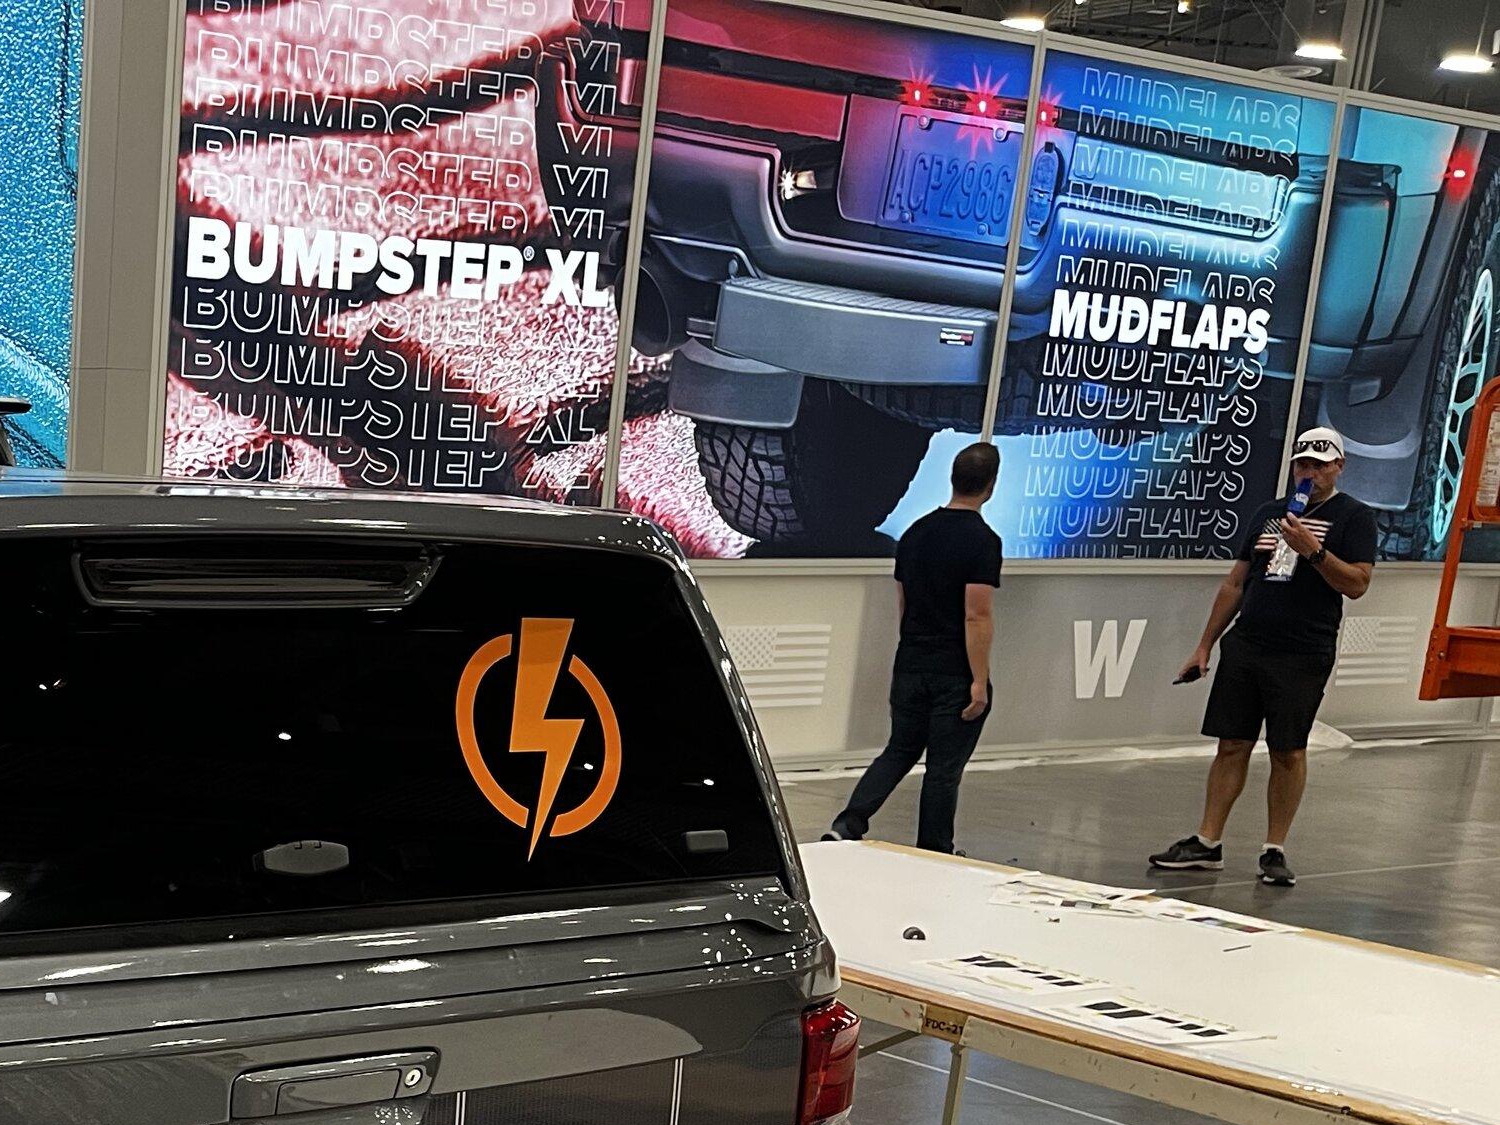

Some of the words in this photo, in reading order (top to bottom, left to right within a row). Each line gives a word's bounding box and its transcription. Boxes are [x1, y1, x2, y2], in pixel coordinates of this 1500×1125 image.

[542, 248, 609, 308] XL
[1049, 288, 1271, 354] MUDFLAPS
[1074, 619, 1148, 699] W
